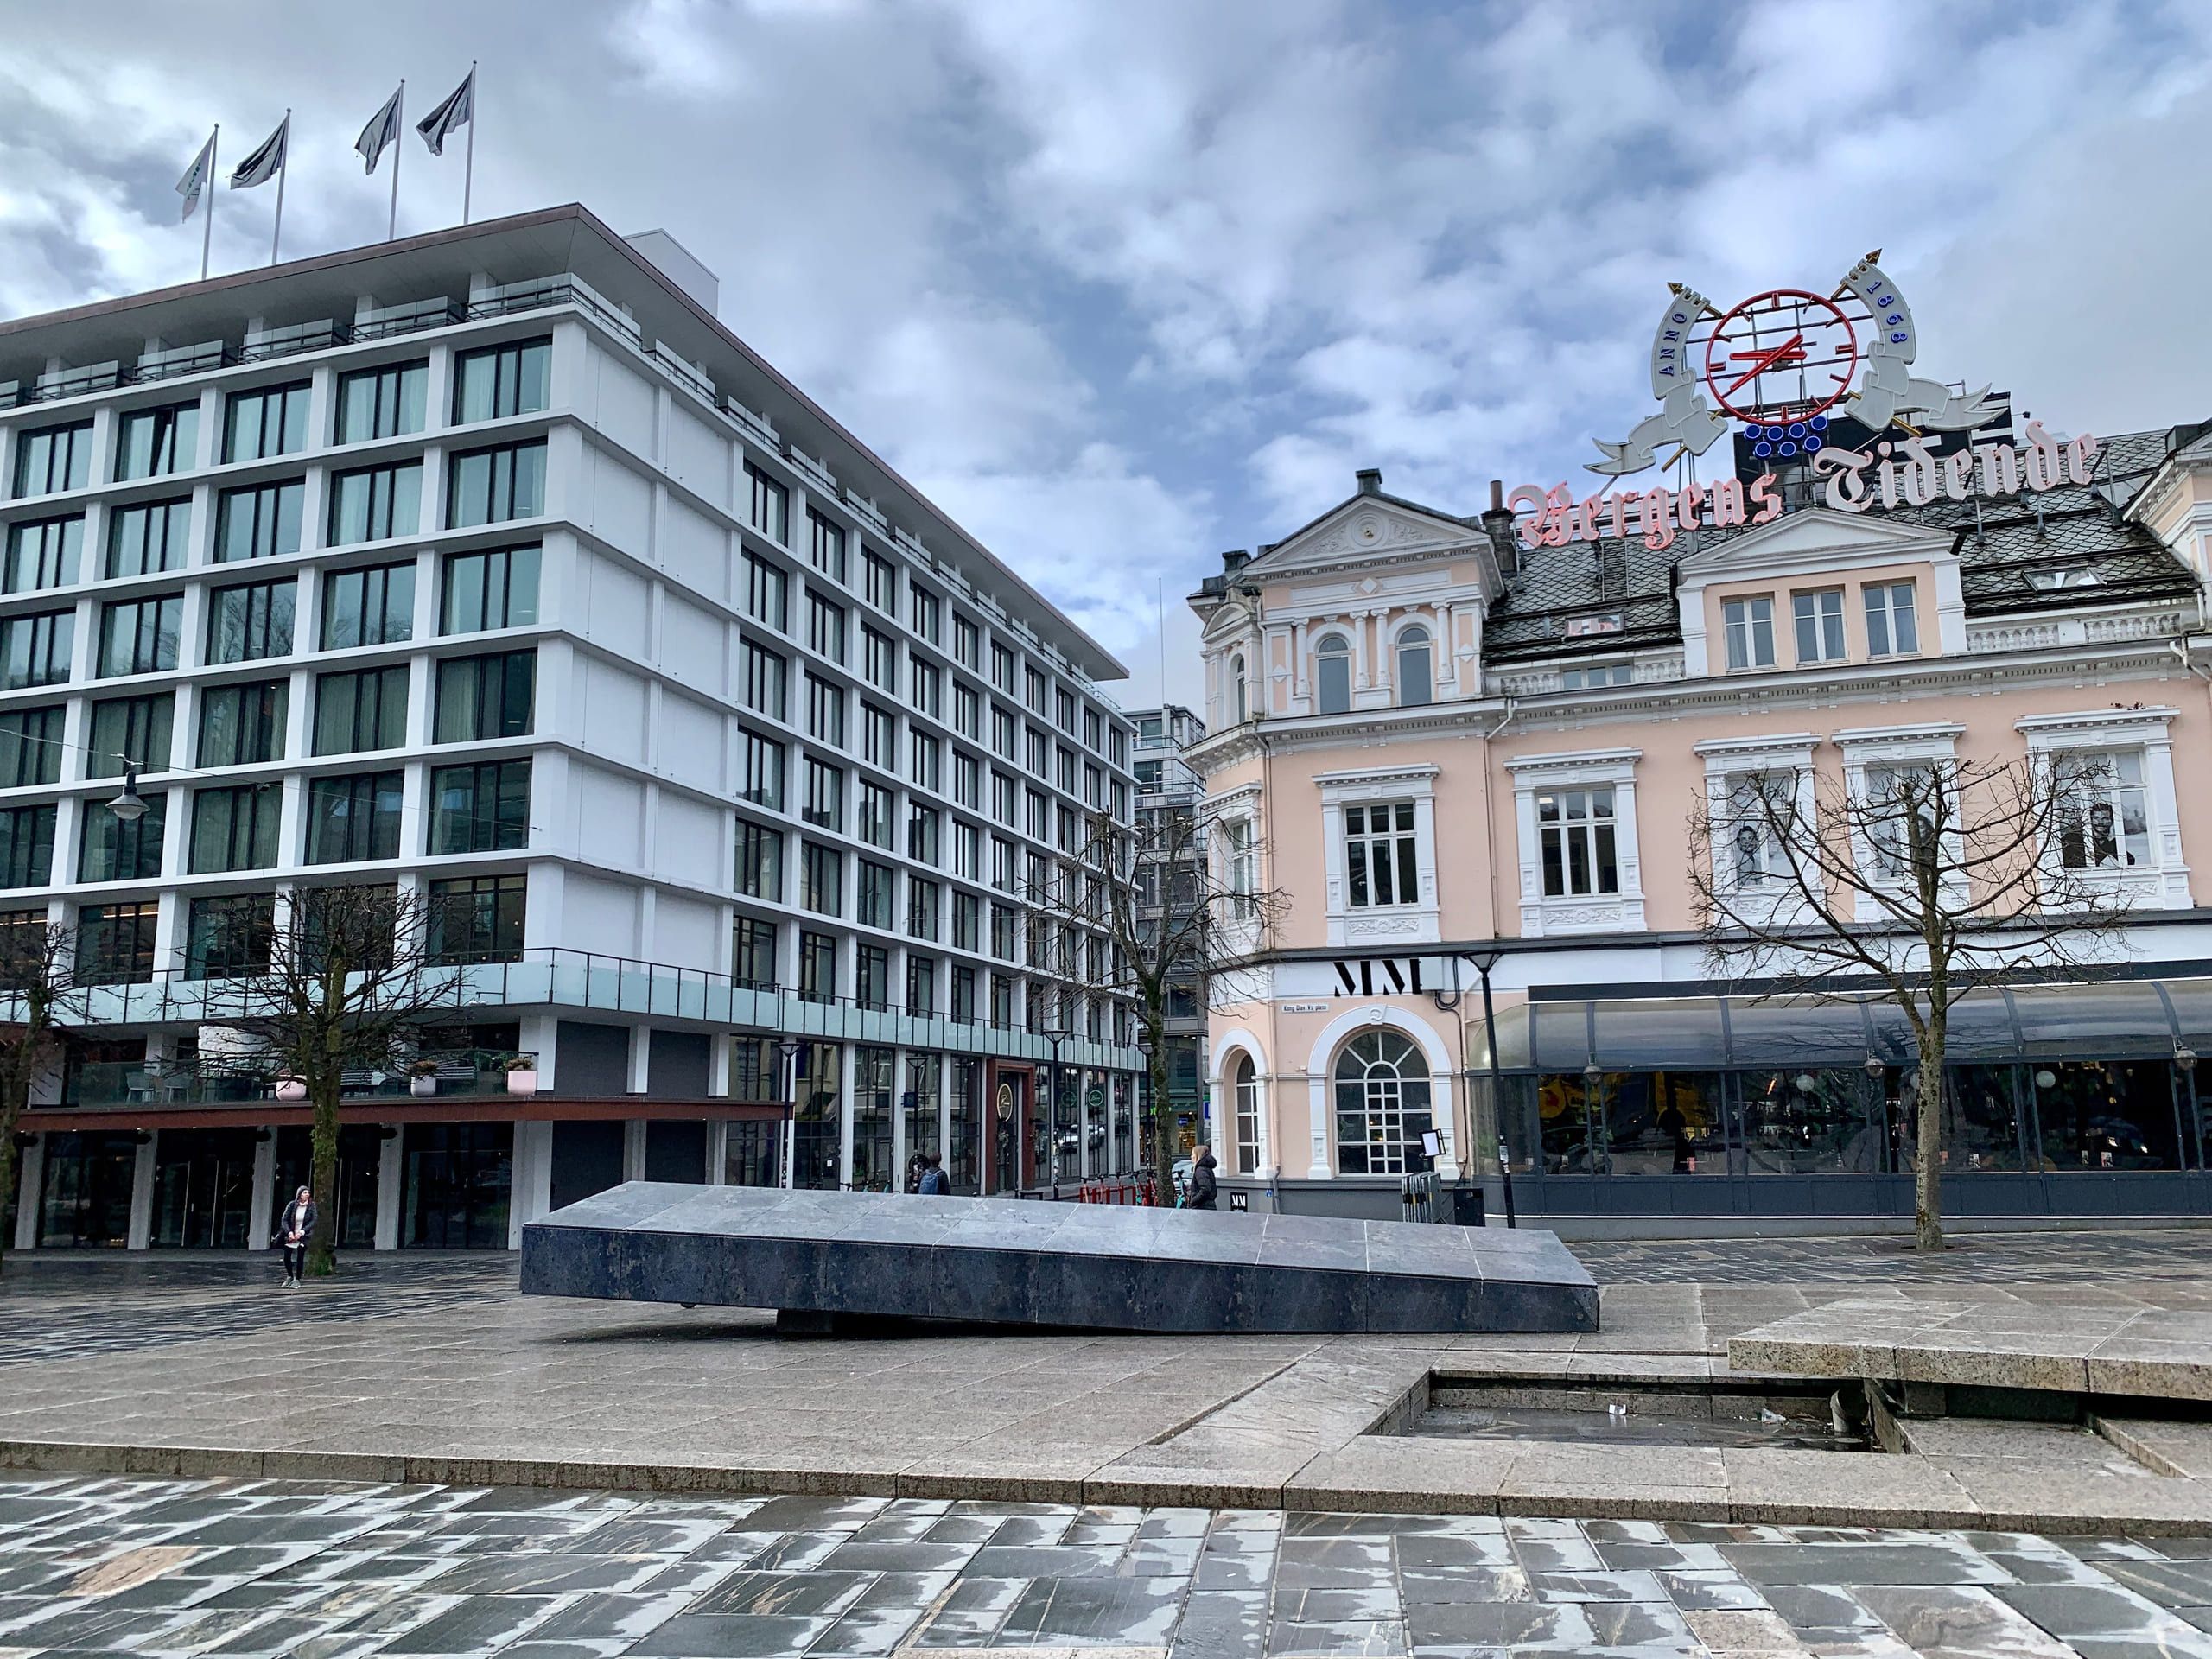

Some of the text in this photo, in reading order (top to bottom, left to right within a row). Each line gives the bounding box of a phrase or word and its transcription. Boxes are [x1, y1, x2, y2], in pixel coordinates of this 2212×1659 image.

[1659, 281, 1908, 377] ANNO 1868
[1507, 420, 2097, 551] Bergens Tidende
[1231, 1194, 1246, 1207] MM
